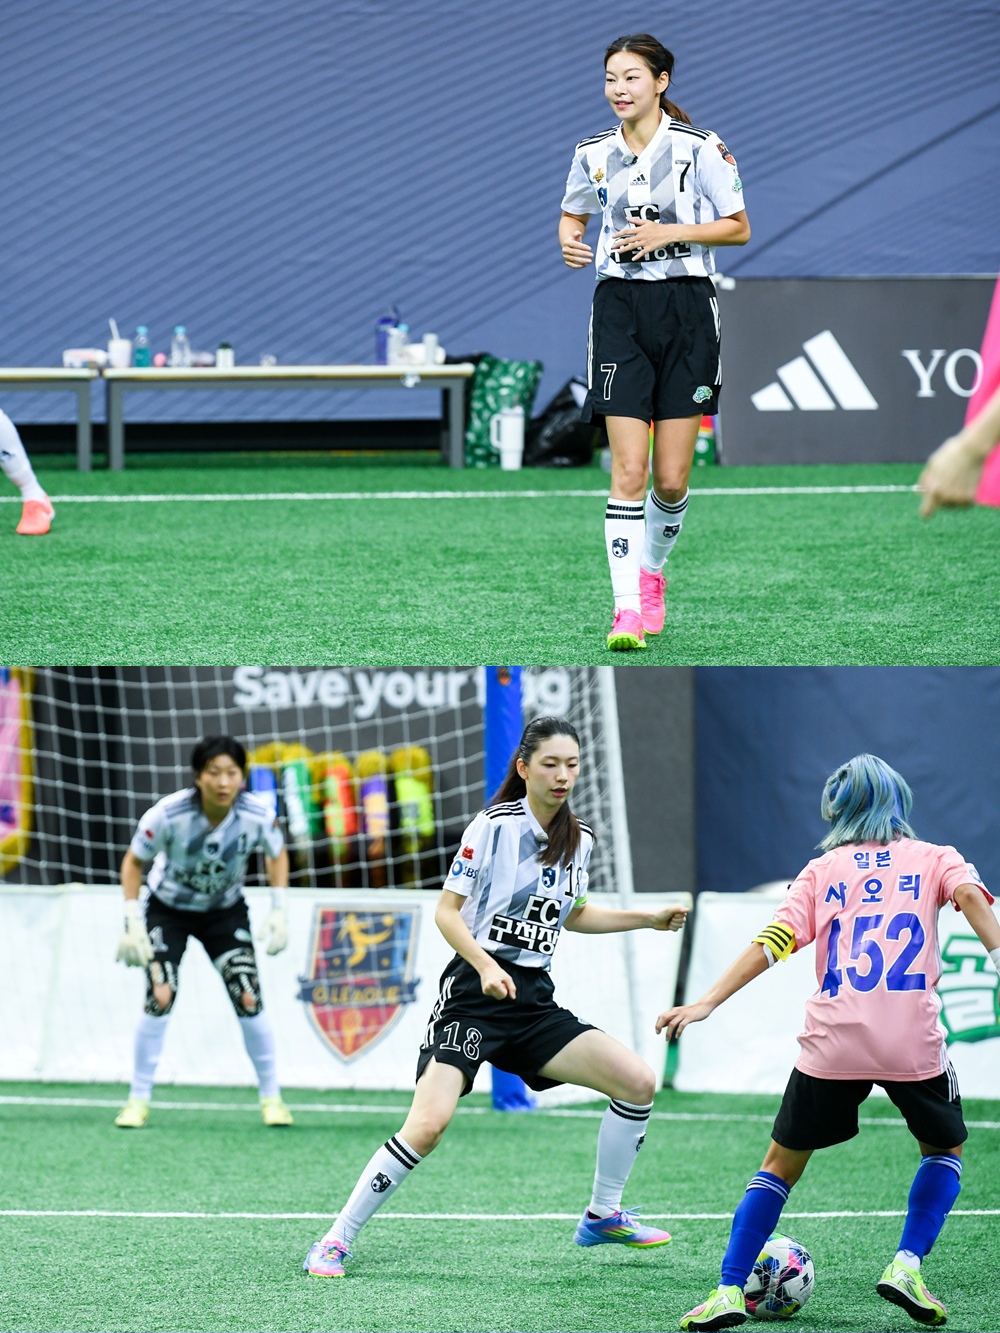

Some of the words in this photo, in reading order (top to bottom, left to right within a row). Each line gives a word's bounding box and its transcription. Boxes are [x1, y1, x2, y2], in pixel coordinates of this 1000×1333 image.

[675, 160, 691, 192] 7
[600, 363, 617, 400] 7
[233, 667, 350, 706] Save
[354, 672, 468, 719] your
[522, 895, 561, 926] FC
[490, 914, 560, 956] 구척장
[821, 912, 927, 998] 452
[440, 1021, 482, 1061] 18
